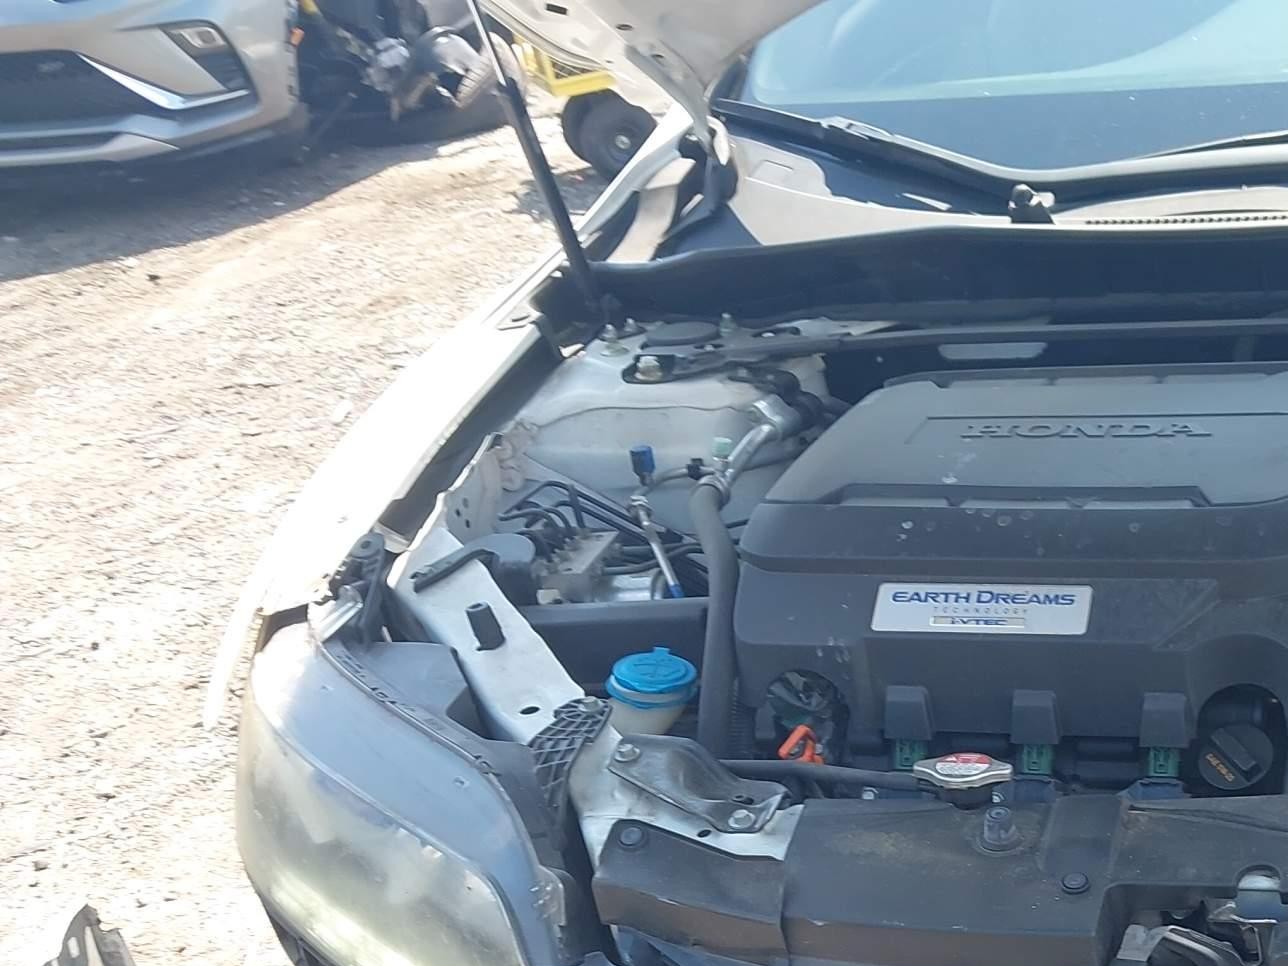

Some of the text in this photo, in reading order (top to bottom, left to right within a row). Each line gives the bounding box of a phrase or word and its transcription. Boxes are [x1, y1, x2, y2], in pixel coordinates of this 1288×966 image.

[960, 423, 1212, 439] HONDA
[892, 590, 1076, 606] EARTH DREAMS
